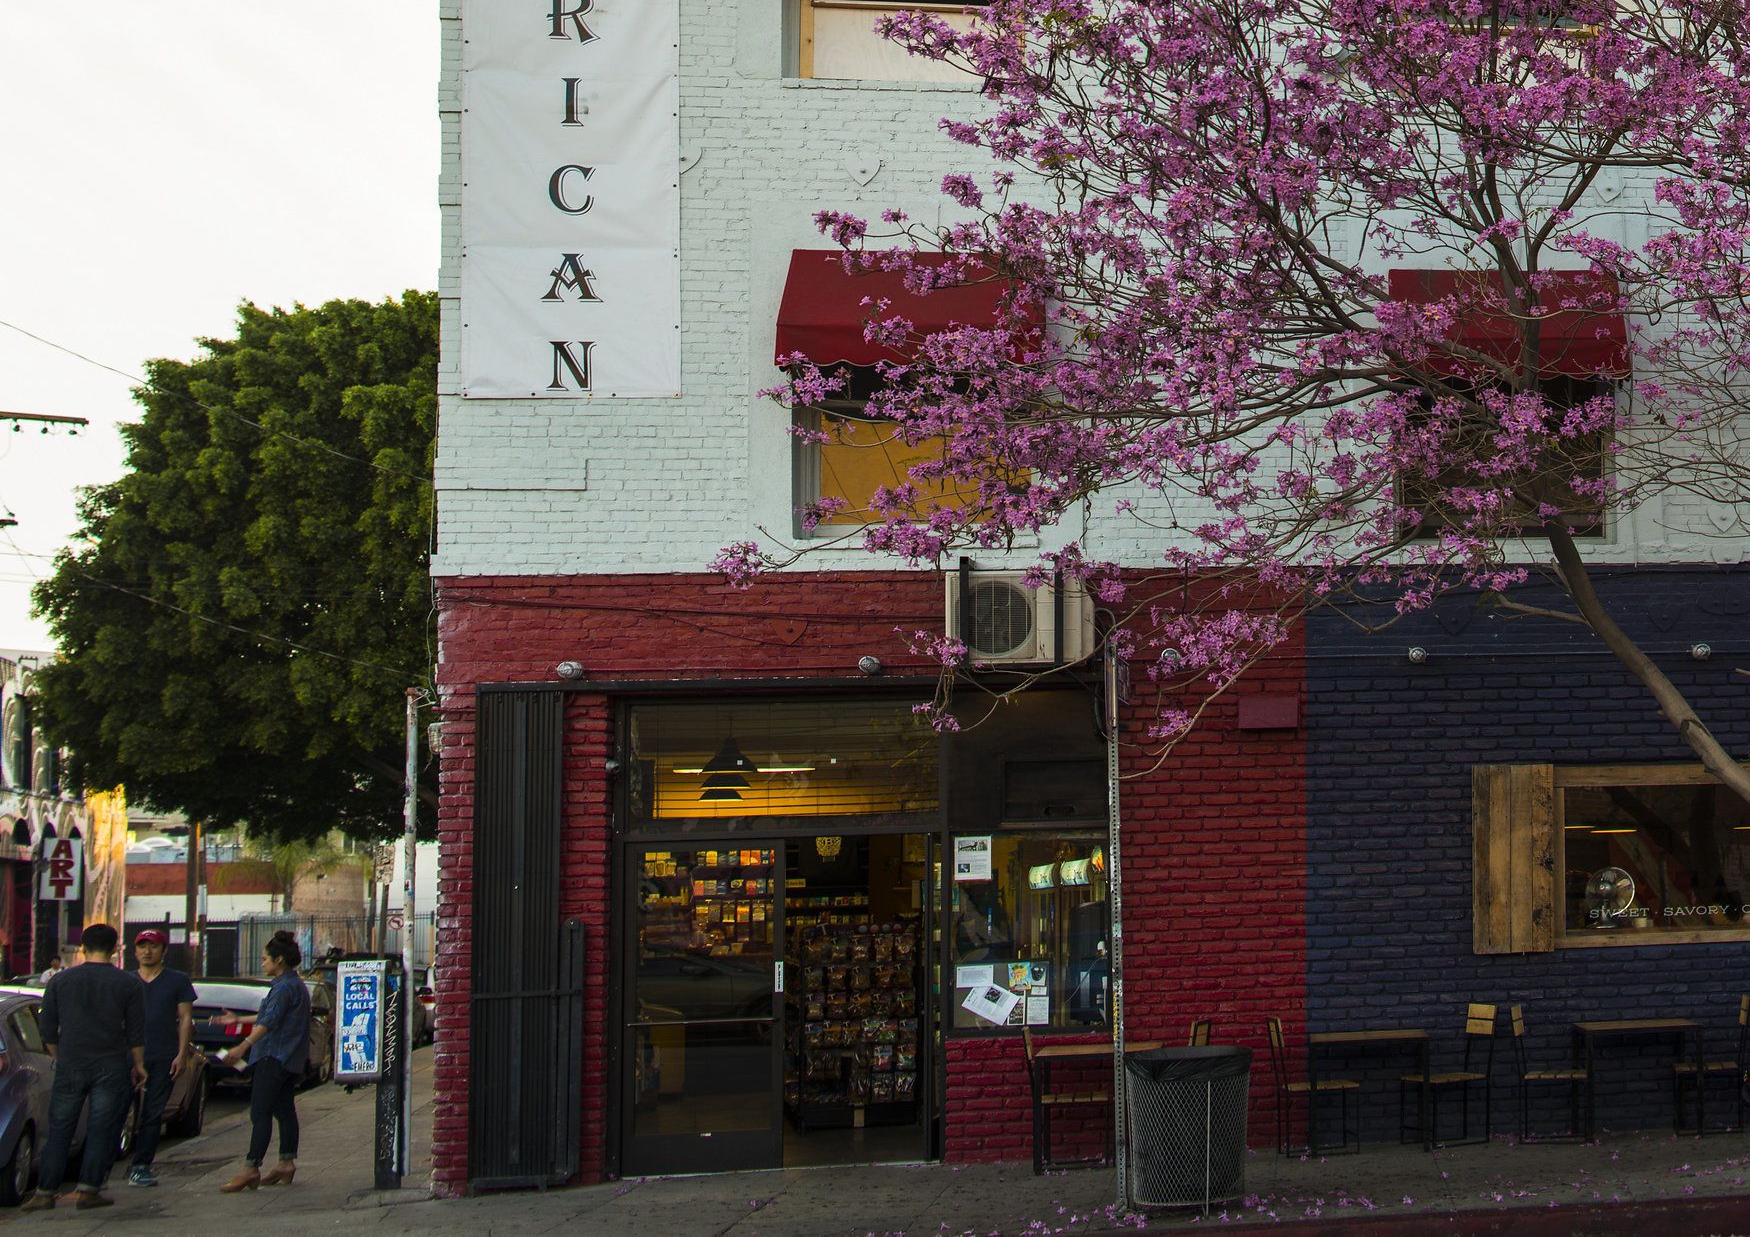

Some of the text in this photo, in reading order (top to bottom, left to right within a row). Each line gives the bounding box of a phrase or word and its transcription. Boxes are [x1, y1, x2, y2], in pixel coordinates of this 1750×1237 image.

[48, 839, 75, 899] ART
[1589, 907, 1650, 919] SWEET
[1663, 905, 1729, 917] SAVORY
[345, 993, 375, 1001] LOCAL
[345, 1001, 375, 1010] CALLS
